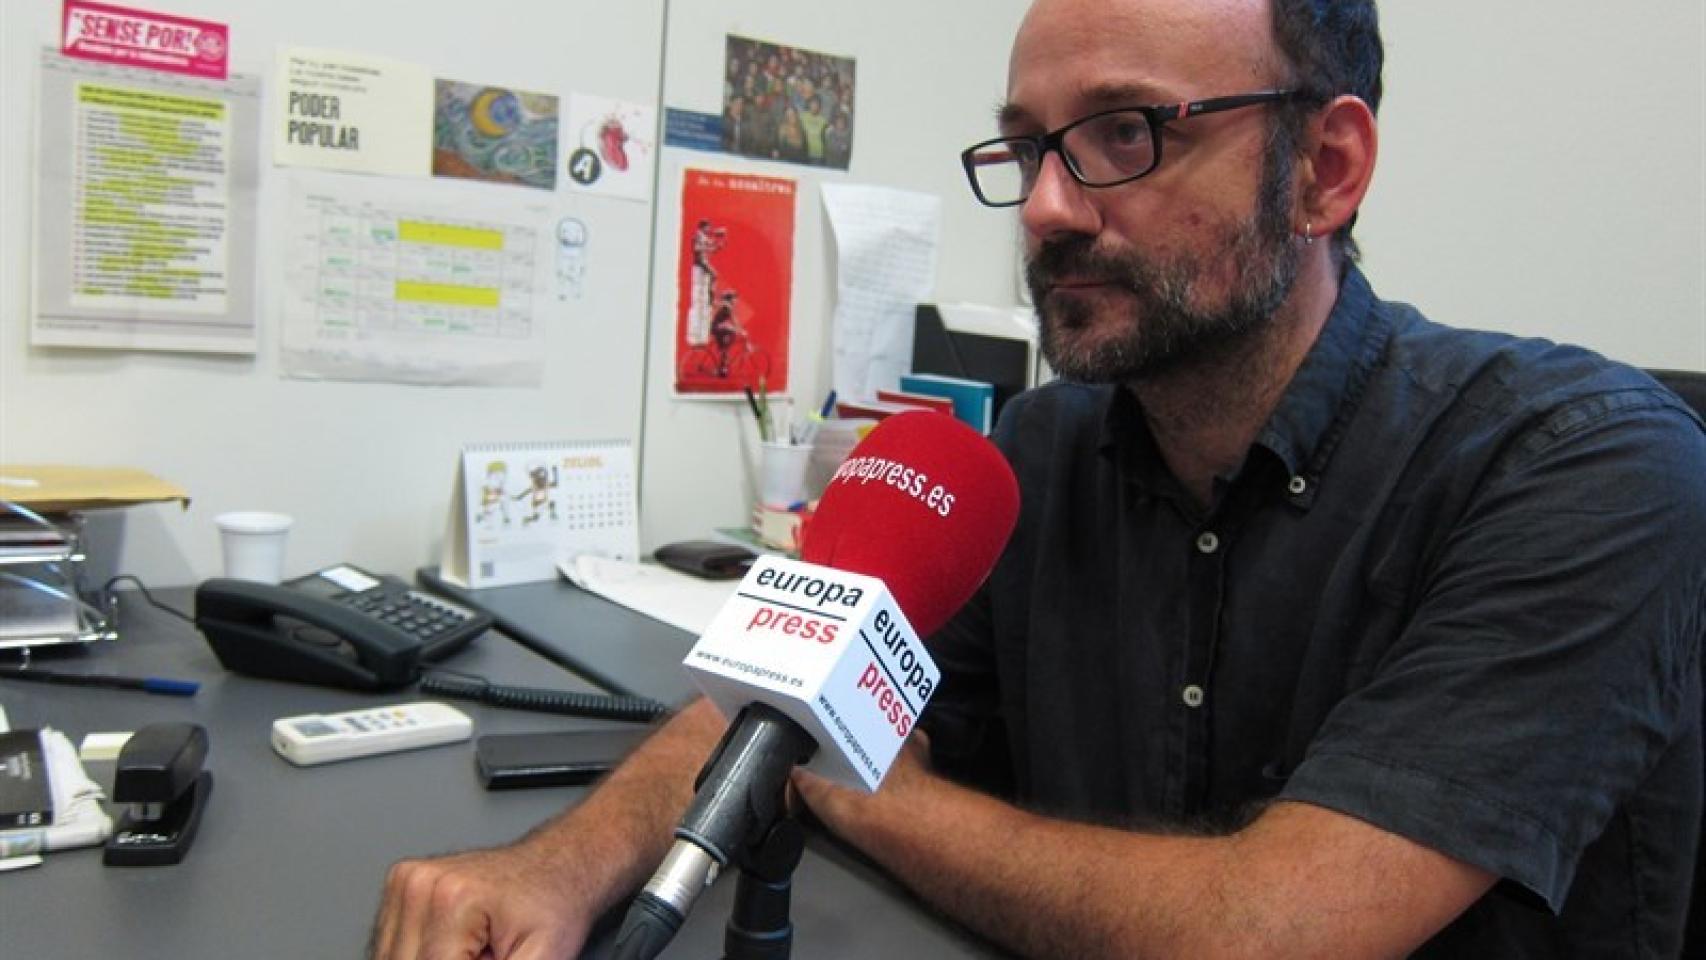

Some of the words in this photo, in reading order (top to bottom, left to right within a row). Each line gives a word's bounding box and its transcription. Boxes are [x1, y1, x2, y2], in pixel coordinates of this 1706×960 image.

[147, 25, 193, 51] POR!
[288, 91, 340, 120] PODER
[288, 119, 359, 151] POPULAR
[755, 567, 864, 607] europa
[746, 606, 839, 644] press
[696, 650, 804, 688] www.europapress.es
[873, 609, 933, 701] europa
[857, 661, 912, 738] press
